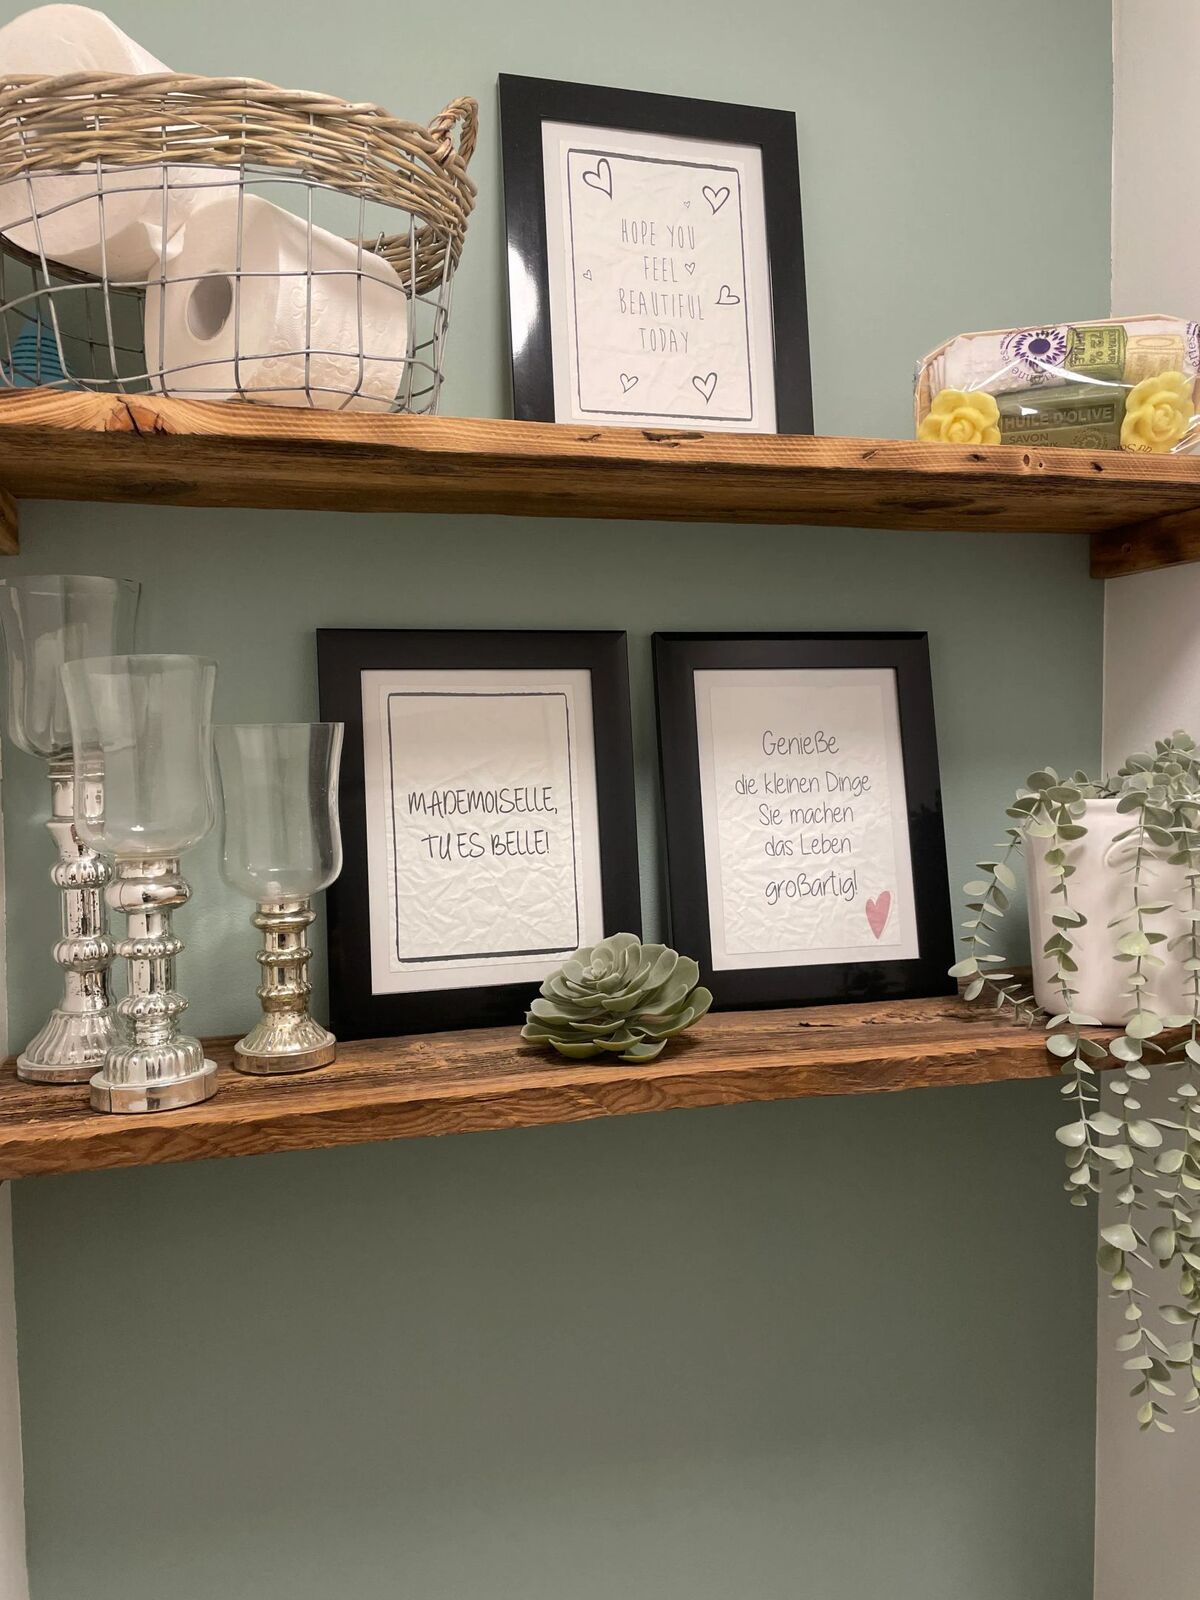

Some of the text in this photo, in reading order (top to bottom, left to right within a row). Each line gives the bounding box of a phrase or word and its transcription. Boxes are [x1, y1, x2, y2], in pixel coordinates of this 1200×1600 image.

[621, 218, 695, 250] HOPE YOU
[643, 256, 679, 283] FEEL
[619, 288, 705, 320] BEAUTIFUL
[639, 328, 689, 354] TODAY
[1005, 407, 1112, 429] HUILE D'OLIVE
[1009, 432, 1049, 445] SAVON
[735, 771, 872, 797] die kleinen Dinge
[408, 786, 558, 818] MADEMOISELLE,
[758, 801, 854, 826] Sie machen
[421, 830, 550, 861] TU ES BELLE!
[764, 833, 852, 857] das Leben
